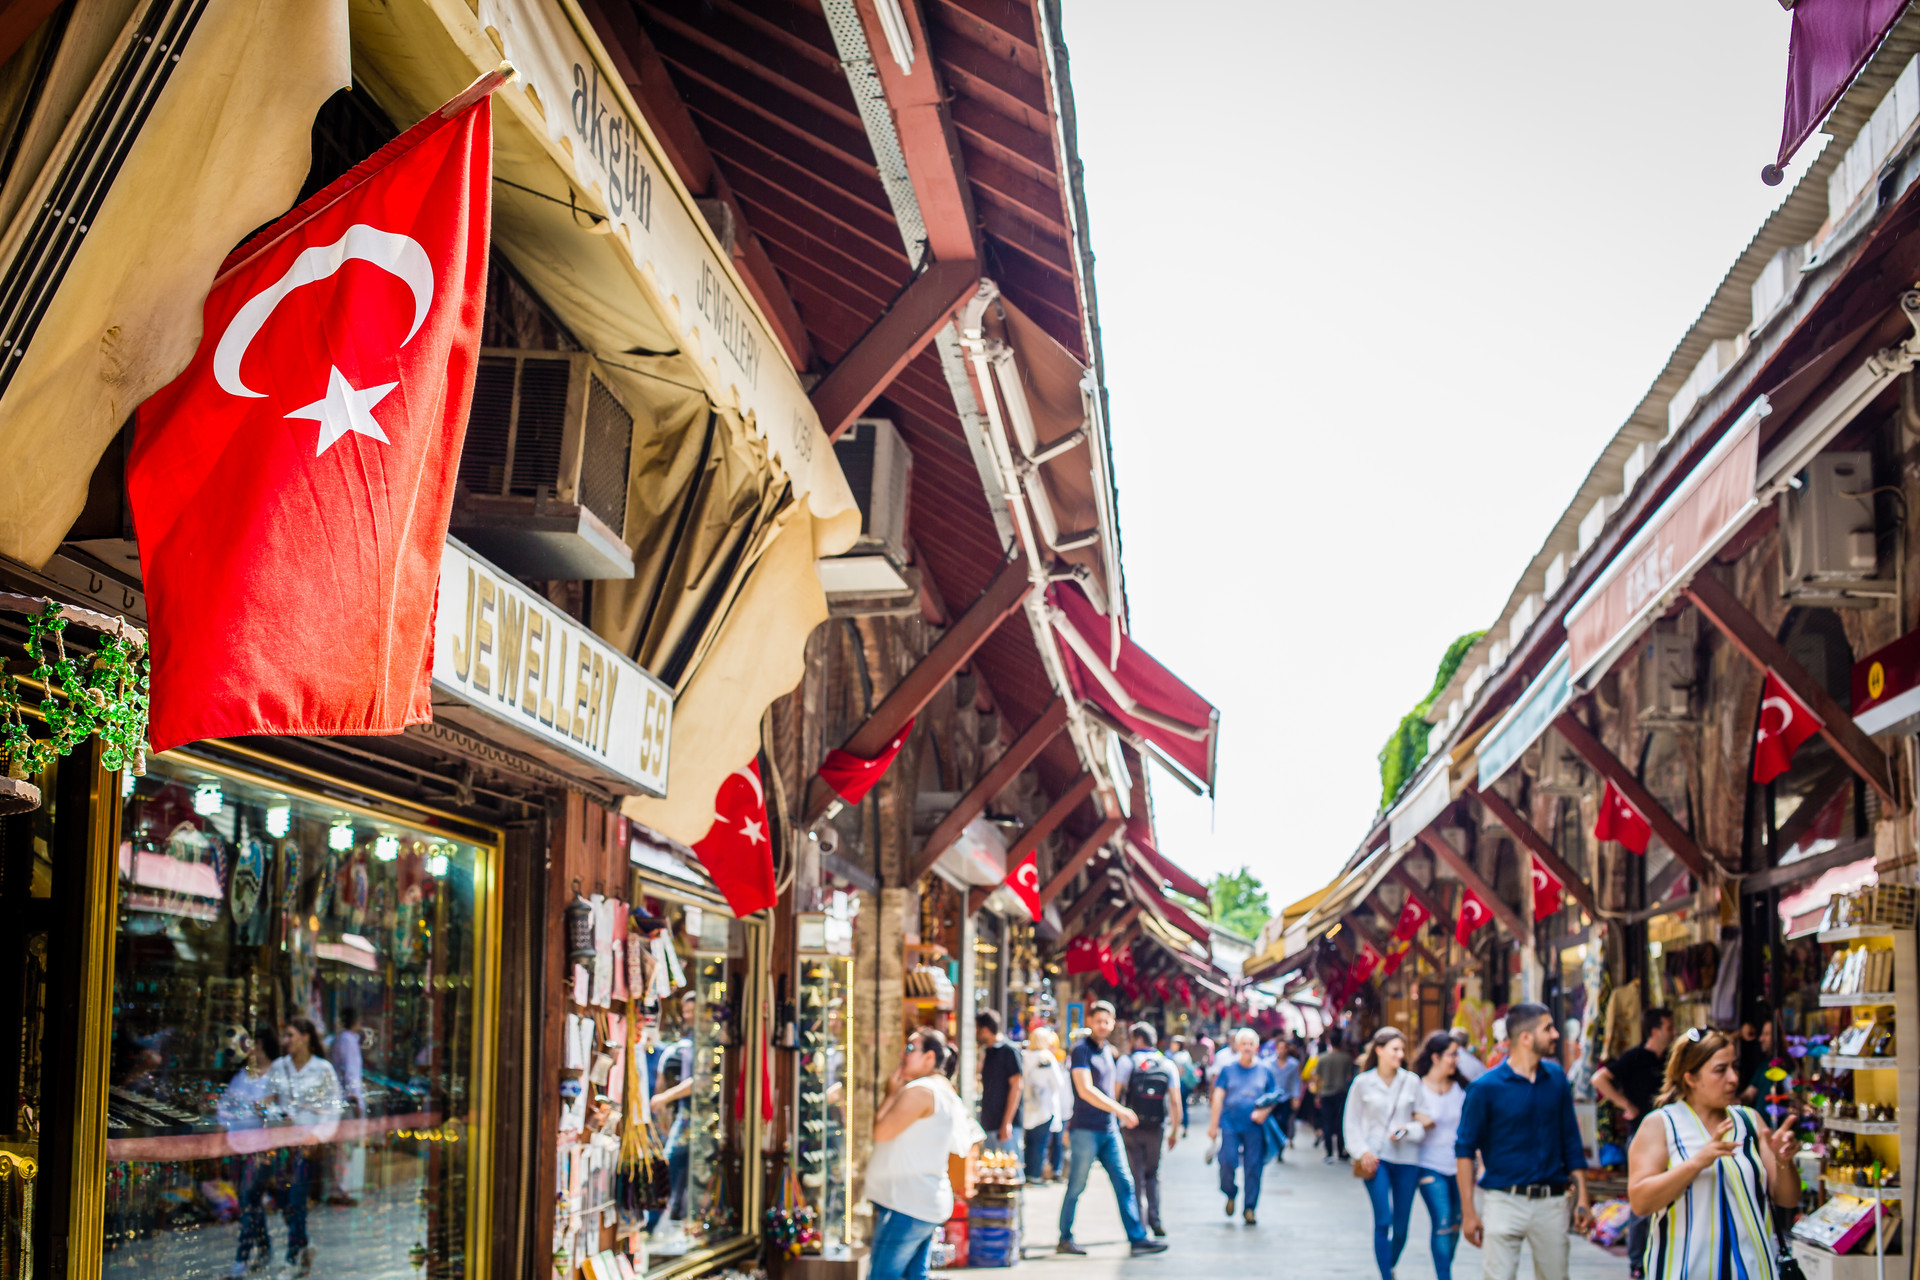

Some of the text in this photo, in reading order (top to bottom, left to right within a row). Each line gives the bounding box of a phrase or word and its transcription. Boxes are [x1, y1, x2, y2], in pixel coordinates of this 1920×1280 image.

[571, 61, 651, 234] akgün
[696, 258, 762, 392] JEWELLERY
[453, 566, 667, 778] JEWELLERY 59
